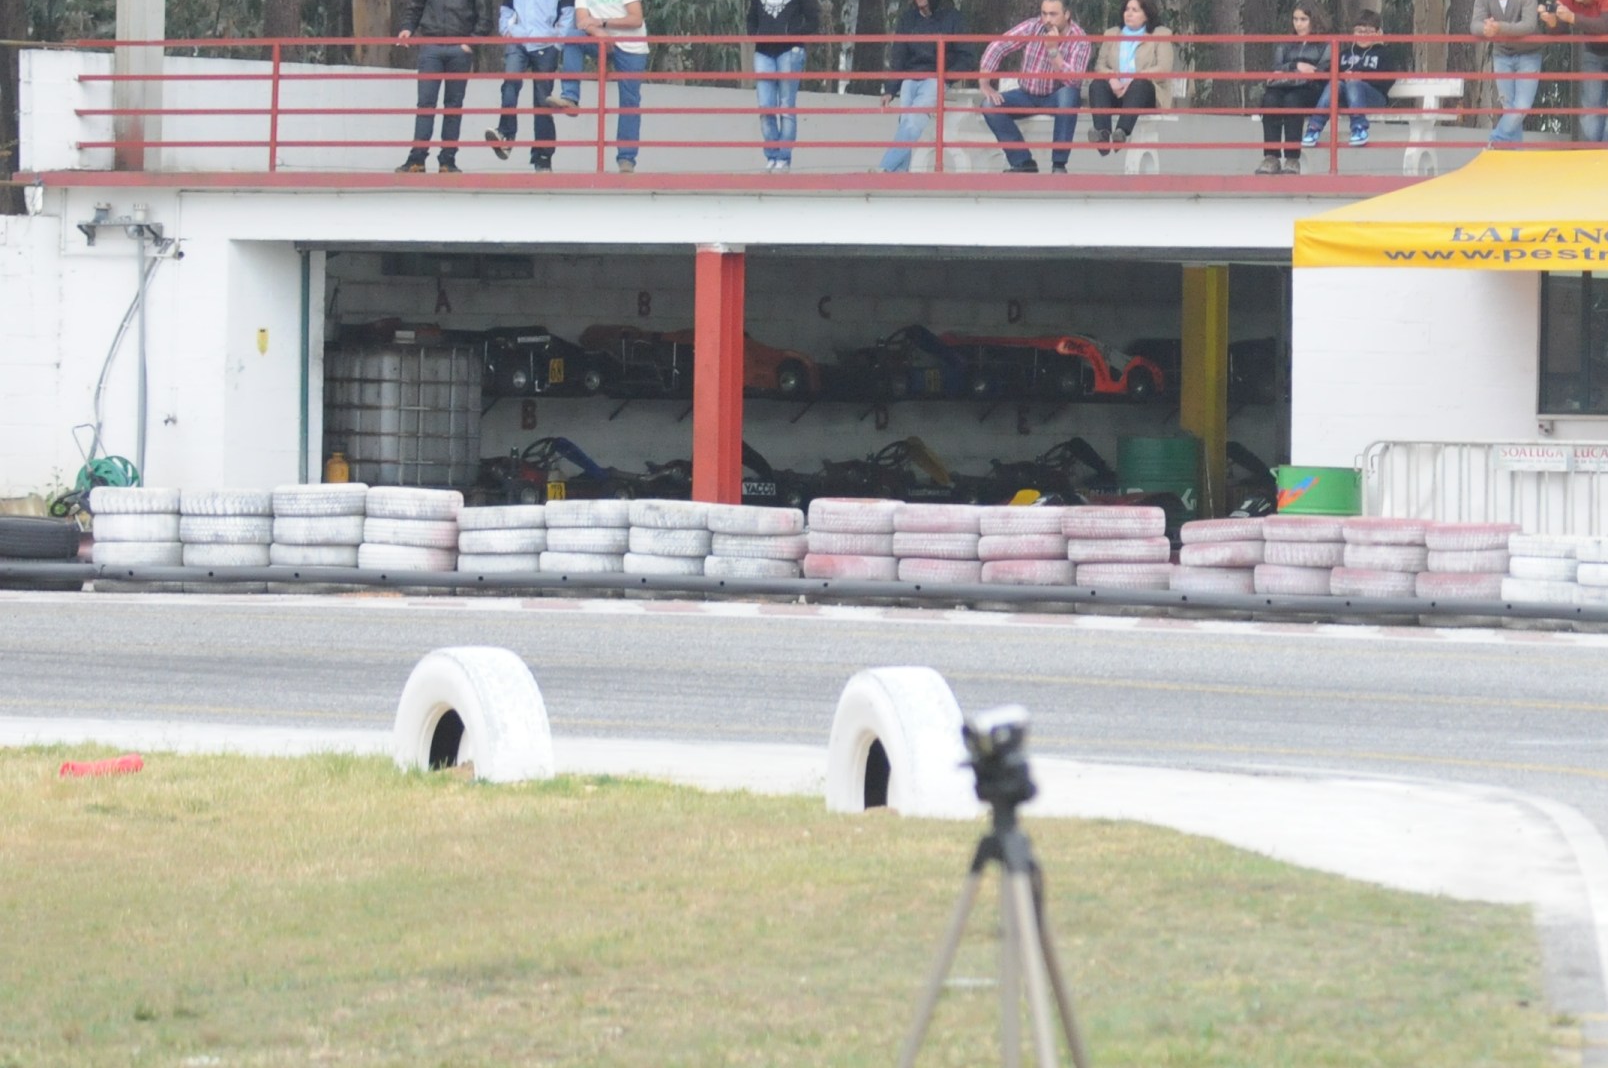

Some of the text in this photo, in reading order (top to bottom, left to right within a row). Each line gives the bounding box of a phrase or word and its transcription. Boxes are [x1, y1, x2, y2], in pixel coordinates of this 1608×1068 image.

[435, 289, 452, 314] A
[638, 291, 651, 316] B
[817, 295, 831, 319] C
[1008, 298, 1021, 323] D
[521, 399, 537, 430] B
[1500, 446, 1564, 458] SOALUGA
[744, 483, 775, 494] YACCO
